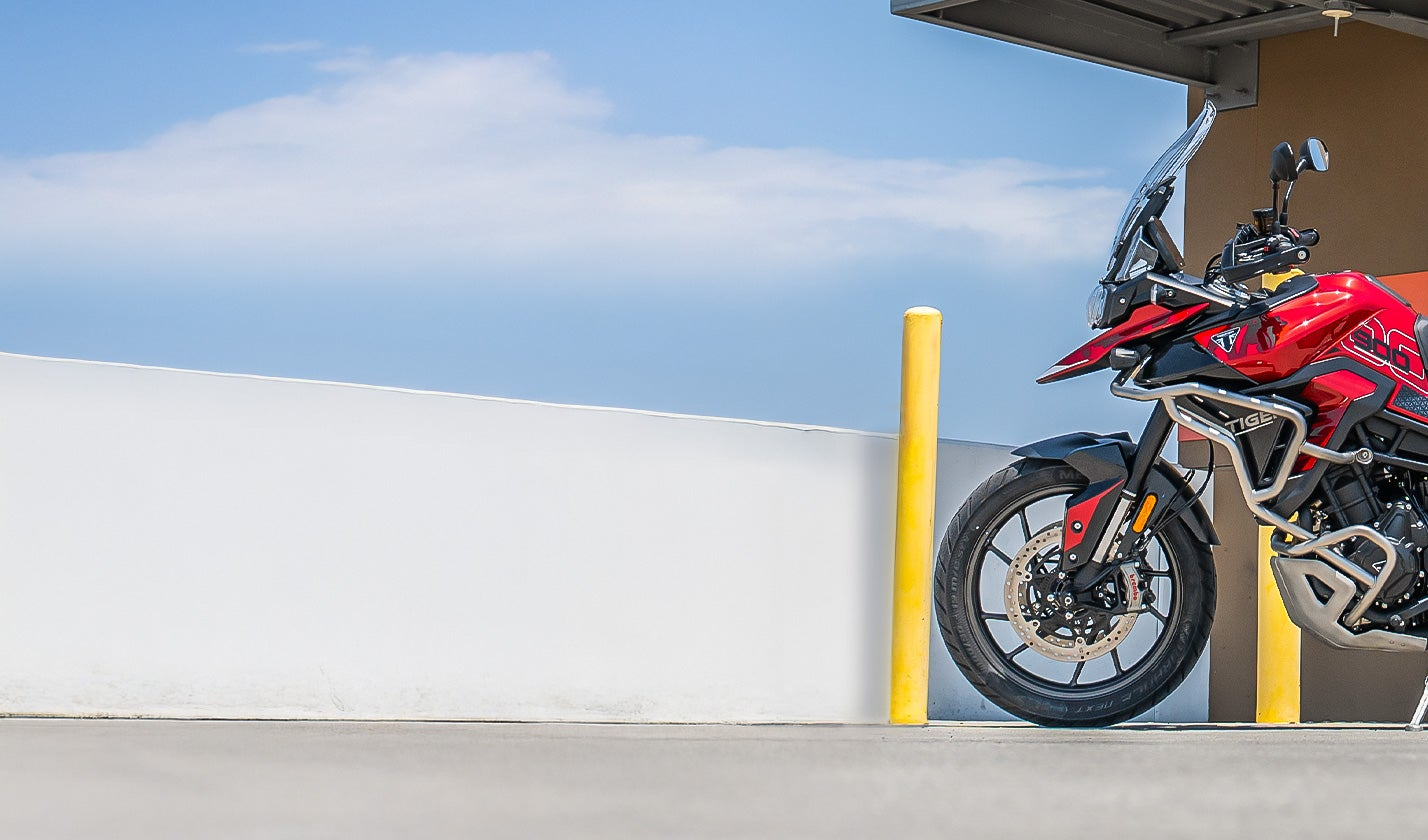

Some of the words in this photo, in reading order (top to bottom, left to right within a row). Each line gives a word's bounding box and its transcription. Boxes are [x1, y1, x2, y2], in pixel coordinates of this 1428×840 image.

[1353, 329, 1410, 373] 900
[1224, 411, 1278, 433] TIGE
[1130, 574, 1139, 600] brembo
